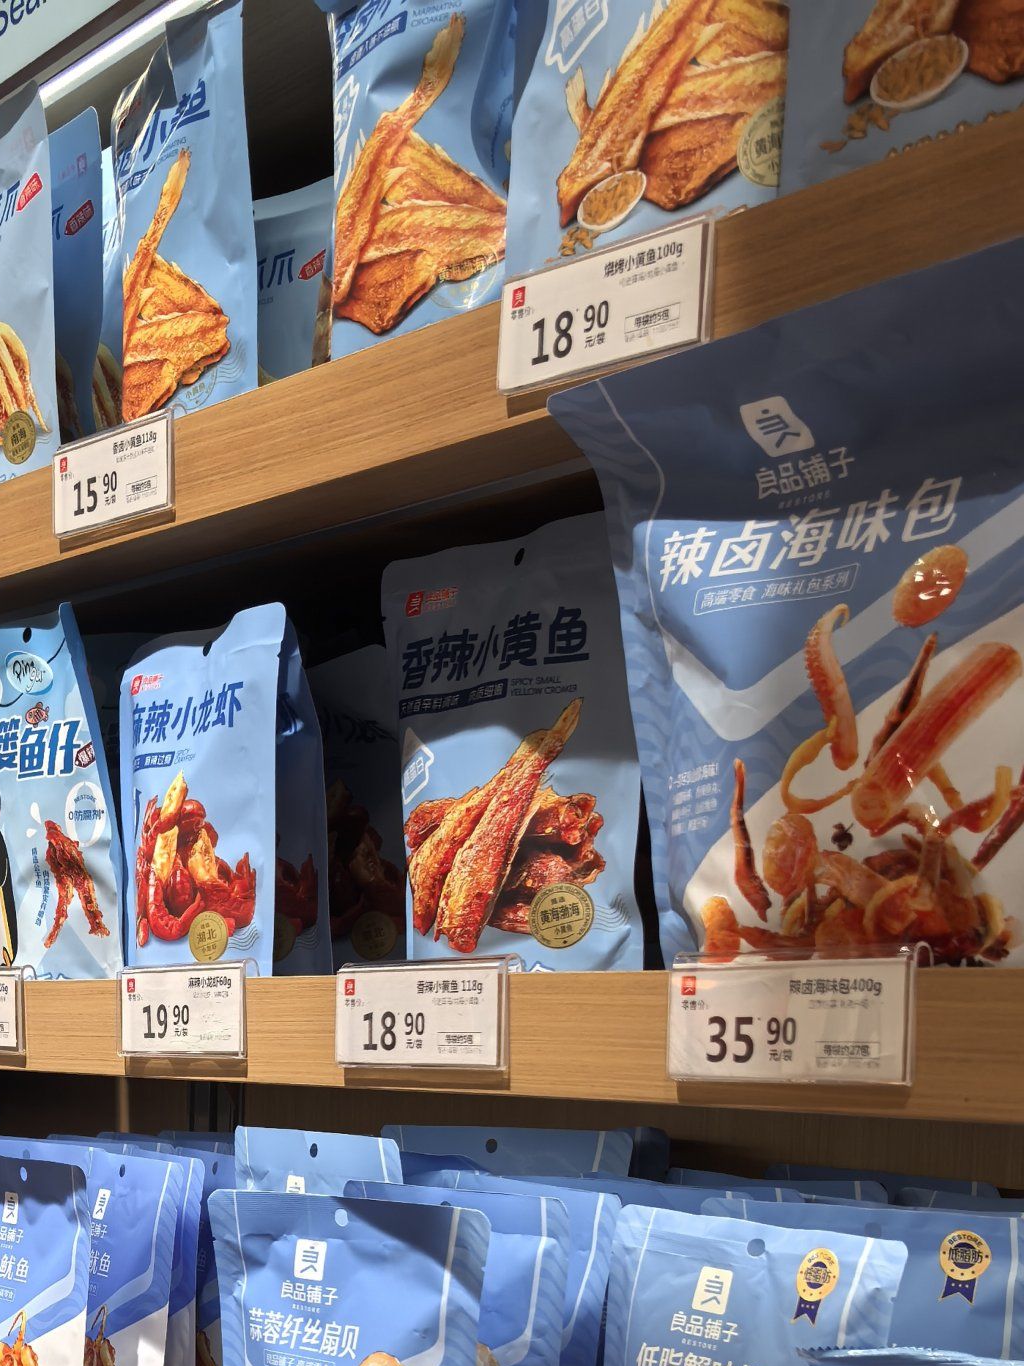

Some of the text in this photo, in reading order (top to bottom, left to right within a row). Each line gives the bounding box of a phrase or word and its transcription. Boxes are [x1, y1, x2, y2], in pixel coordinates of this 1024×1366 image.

[531, 300, 609, 366] 18 90
[73, 471, 118, 517] 15 90
[755, 447, 855, 500] 良品铺子
[659, 476, 963, 593] 辣卤海味包
[699, 585, 757, 609] 高端零食
[402, 606, 590, 691] 香辣小黄鱼
[511, 675, 561, 687] SPICY SMALL
[461, 979, 483, 994] 118g
[142, 1004, 190, 1039] 19 90
[363, 1011, 425, 1051] 18 90
[705, 1016, 797, 1064] 35 90
[281, 1279, 339, 1306] 良品铺子
[248, 1307, 360, 1360] 蒜蓉纤丝扇贝
[669, 1310, 739, 1344] 良品铺子
